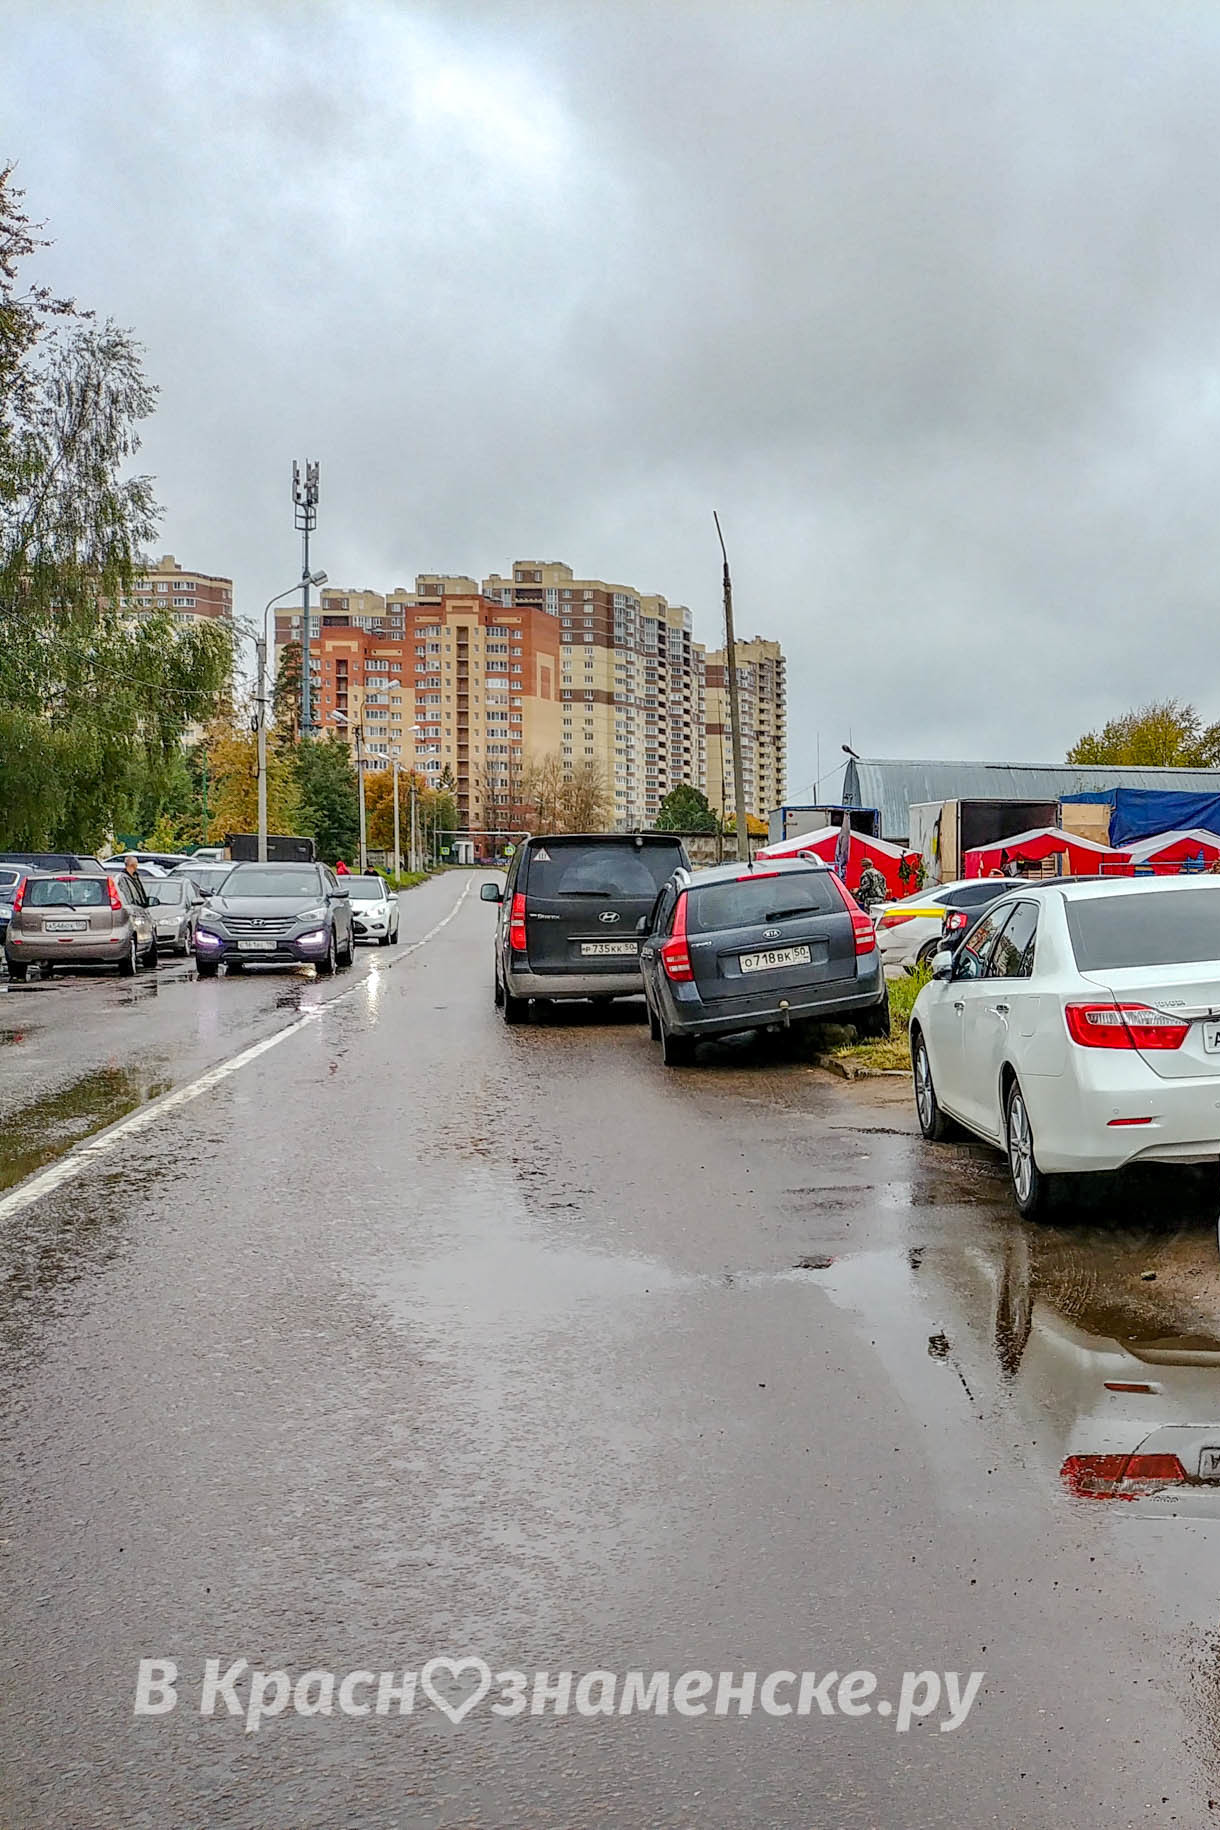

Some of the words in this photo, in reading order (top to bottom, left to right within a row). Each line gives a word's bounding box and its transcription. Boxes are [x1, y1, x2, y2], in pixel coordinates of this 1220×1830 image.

[624, 943, 635, 951] 50
[744, 951, 792, 968] О718ВК
[793, 947, 806, 957] 50
